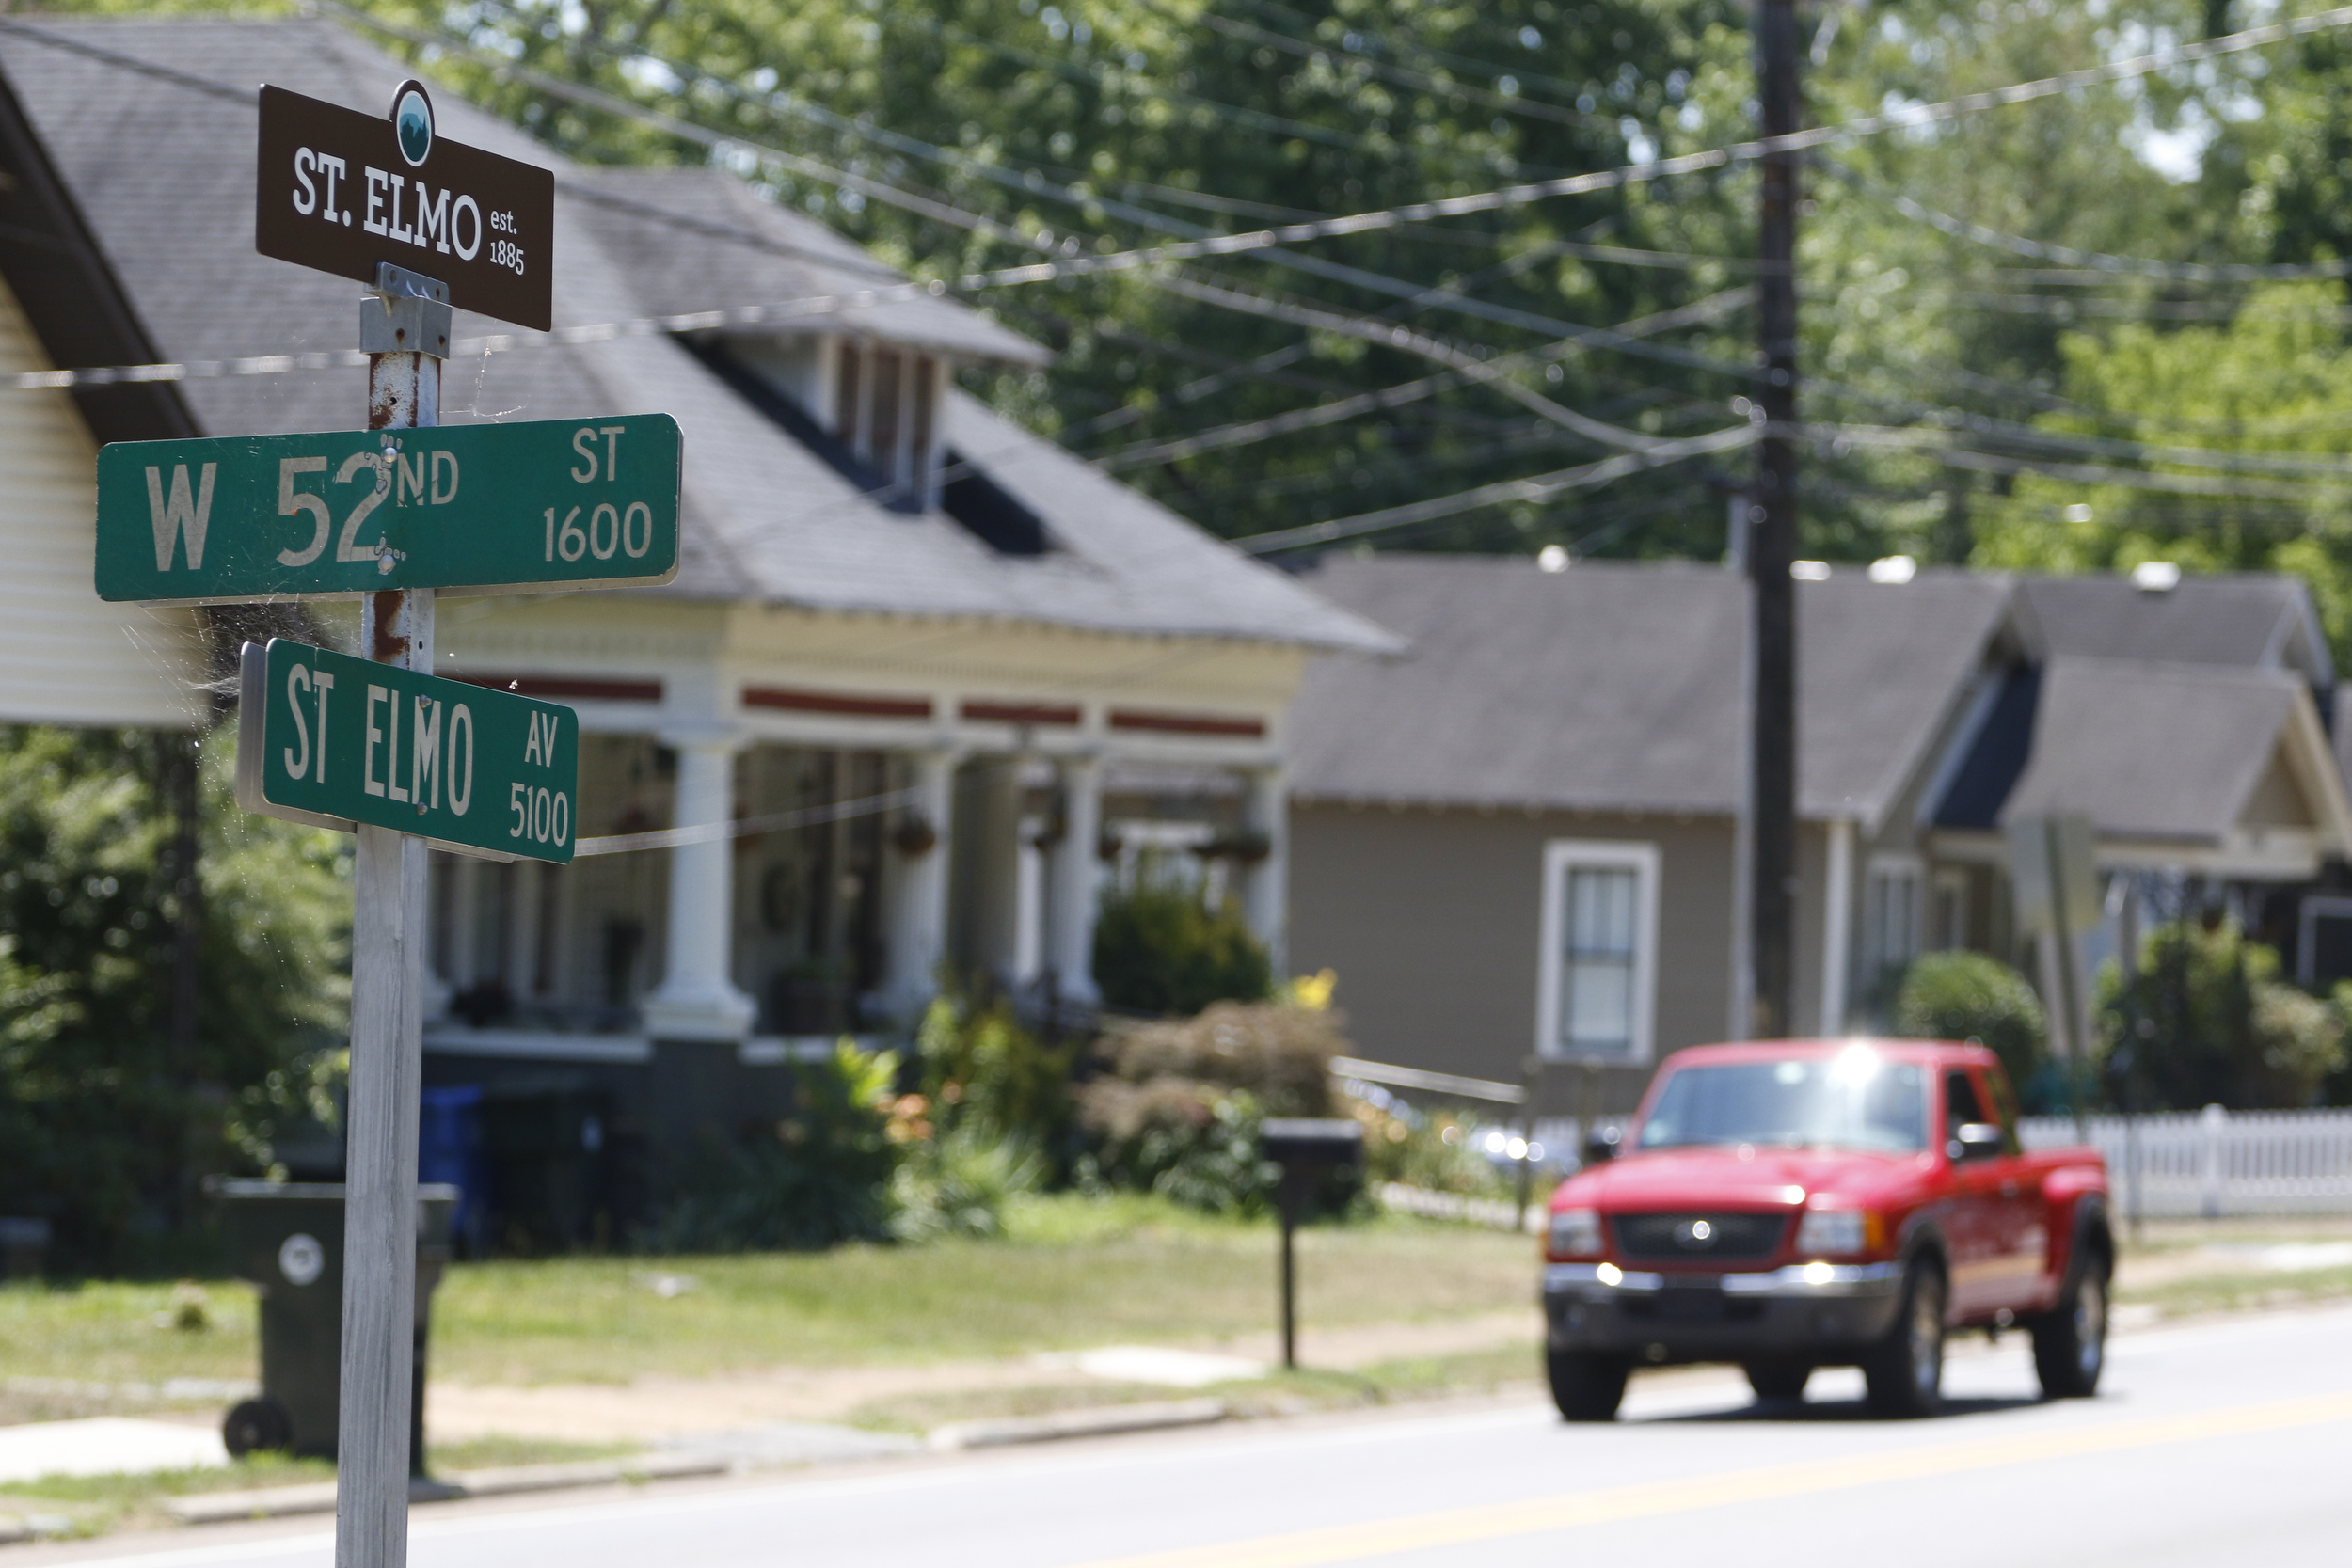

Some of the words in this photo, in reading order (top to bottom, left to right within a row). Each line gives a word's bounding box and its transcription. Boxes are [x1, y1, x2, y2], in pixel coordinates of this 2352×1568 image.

[293, 146, 352, 227] ST.
[363, 166, 482, 261] ELMO
[490, 210, 517, 235] est.
[489, 239, 524, 276] 1885
[570, 425, 626, 483] ST
[144, 462, 217, 572] W
[276, 450, 459, 567] 52ND
[543, 500, 653, 562] 1600
[284, 663, 334, 784] ST
[364, 683, 473, 816] ELMO
[524, 710, 558, 768] AV
[509, 782, 568, 847] 5100
